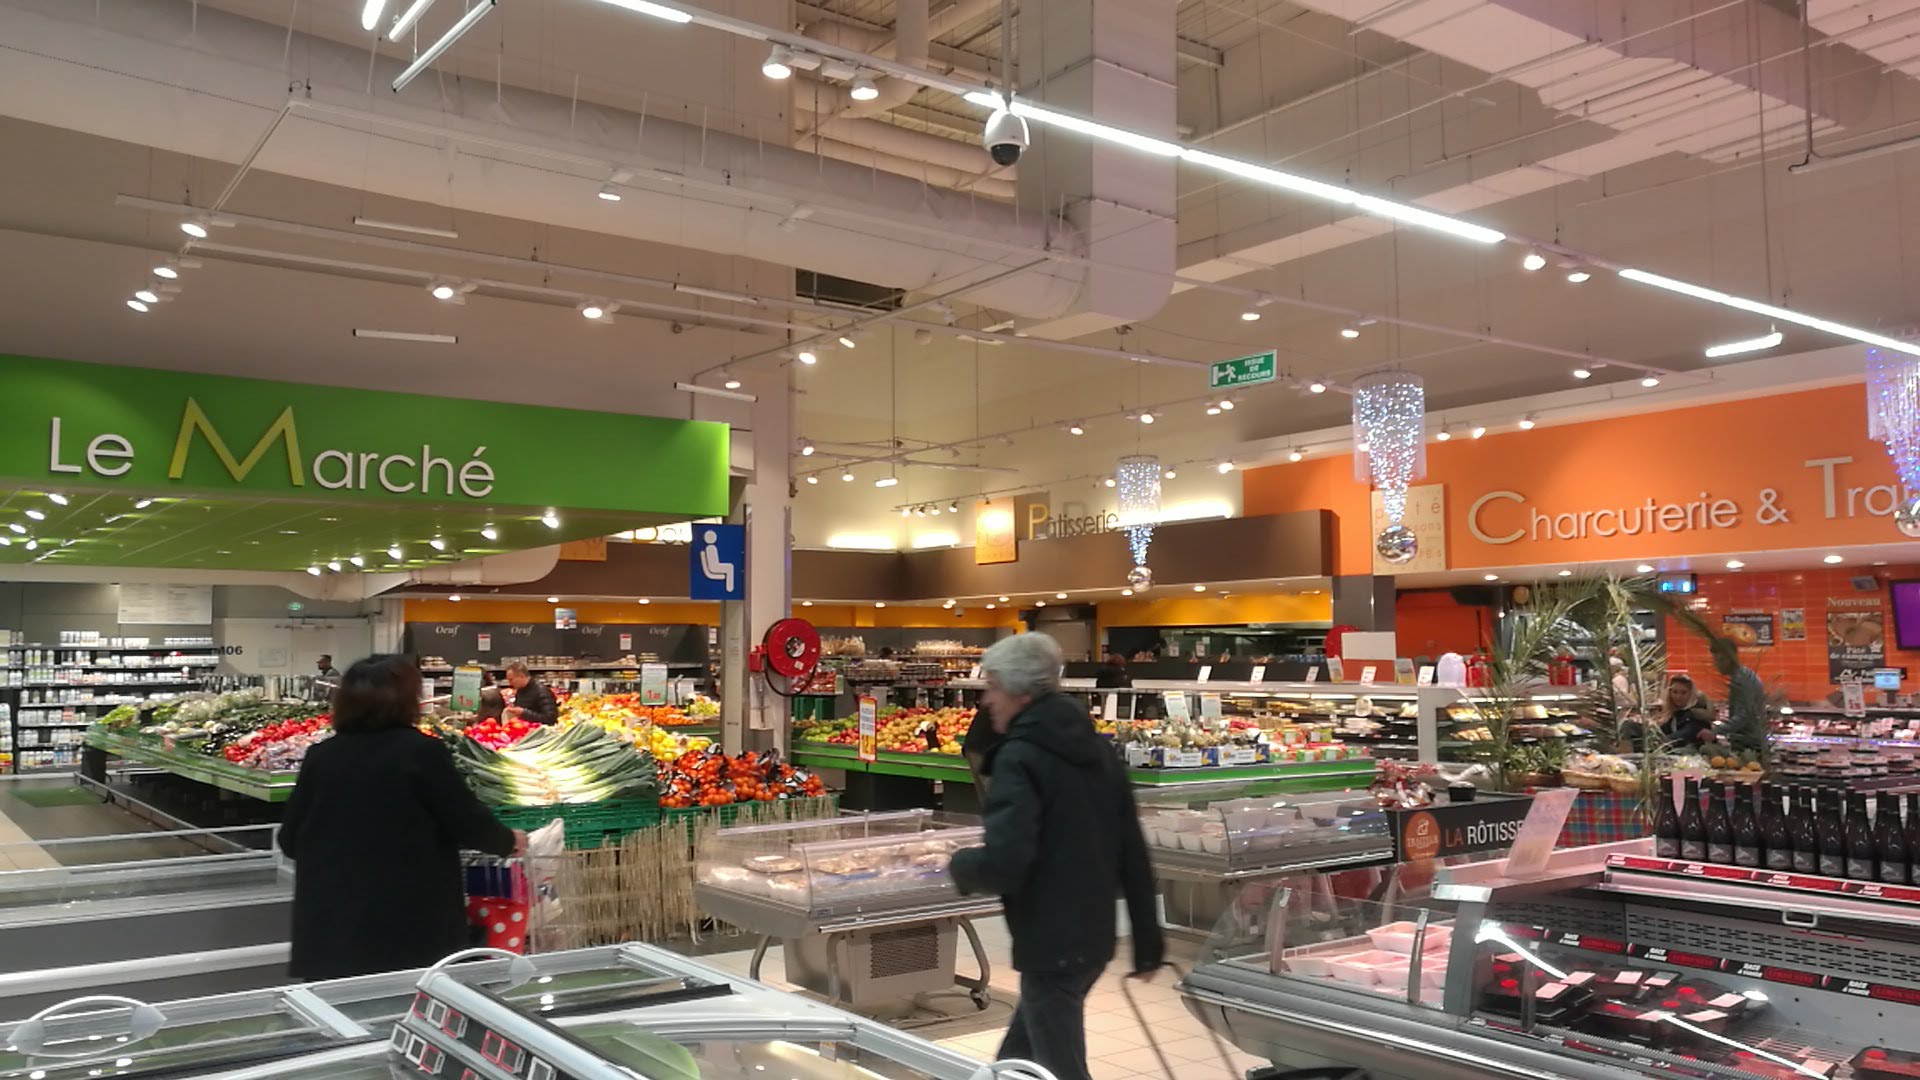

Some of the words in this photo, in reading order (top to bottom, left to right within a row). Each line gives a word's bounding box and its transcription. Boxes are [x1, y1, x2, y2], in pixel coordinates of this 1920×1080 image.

[50, 416, 135, 477] Le
[168, 396, 495, 498] Marché
[1028, 503, 1119, 540] Pâtisserie
[1468, 490, 1739, 546] Charcuterie
[1755, 488, 1790, 526] &
[1446, 827, 1464, 848] LA
